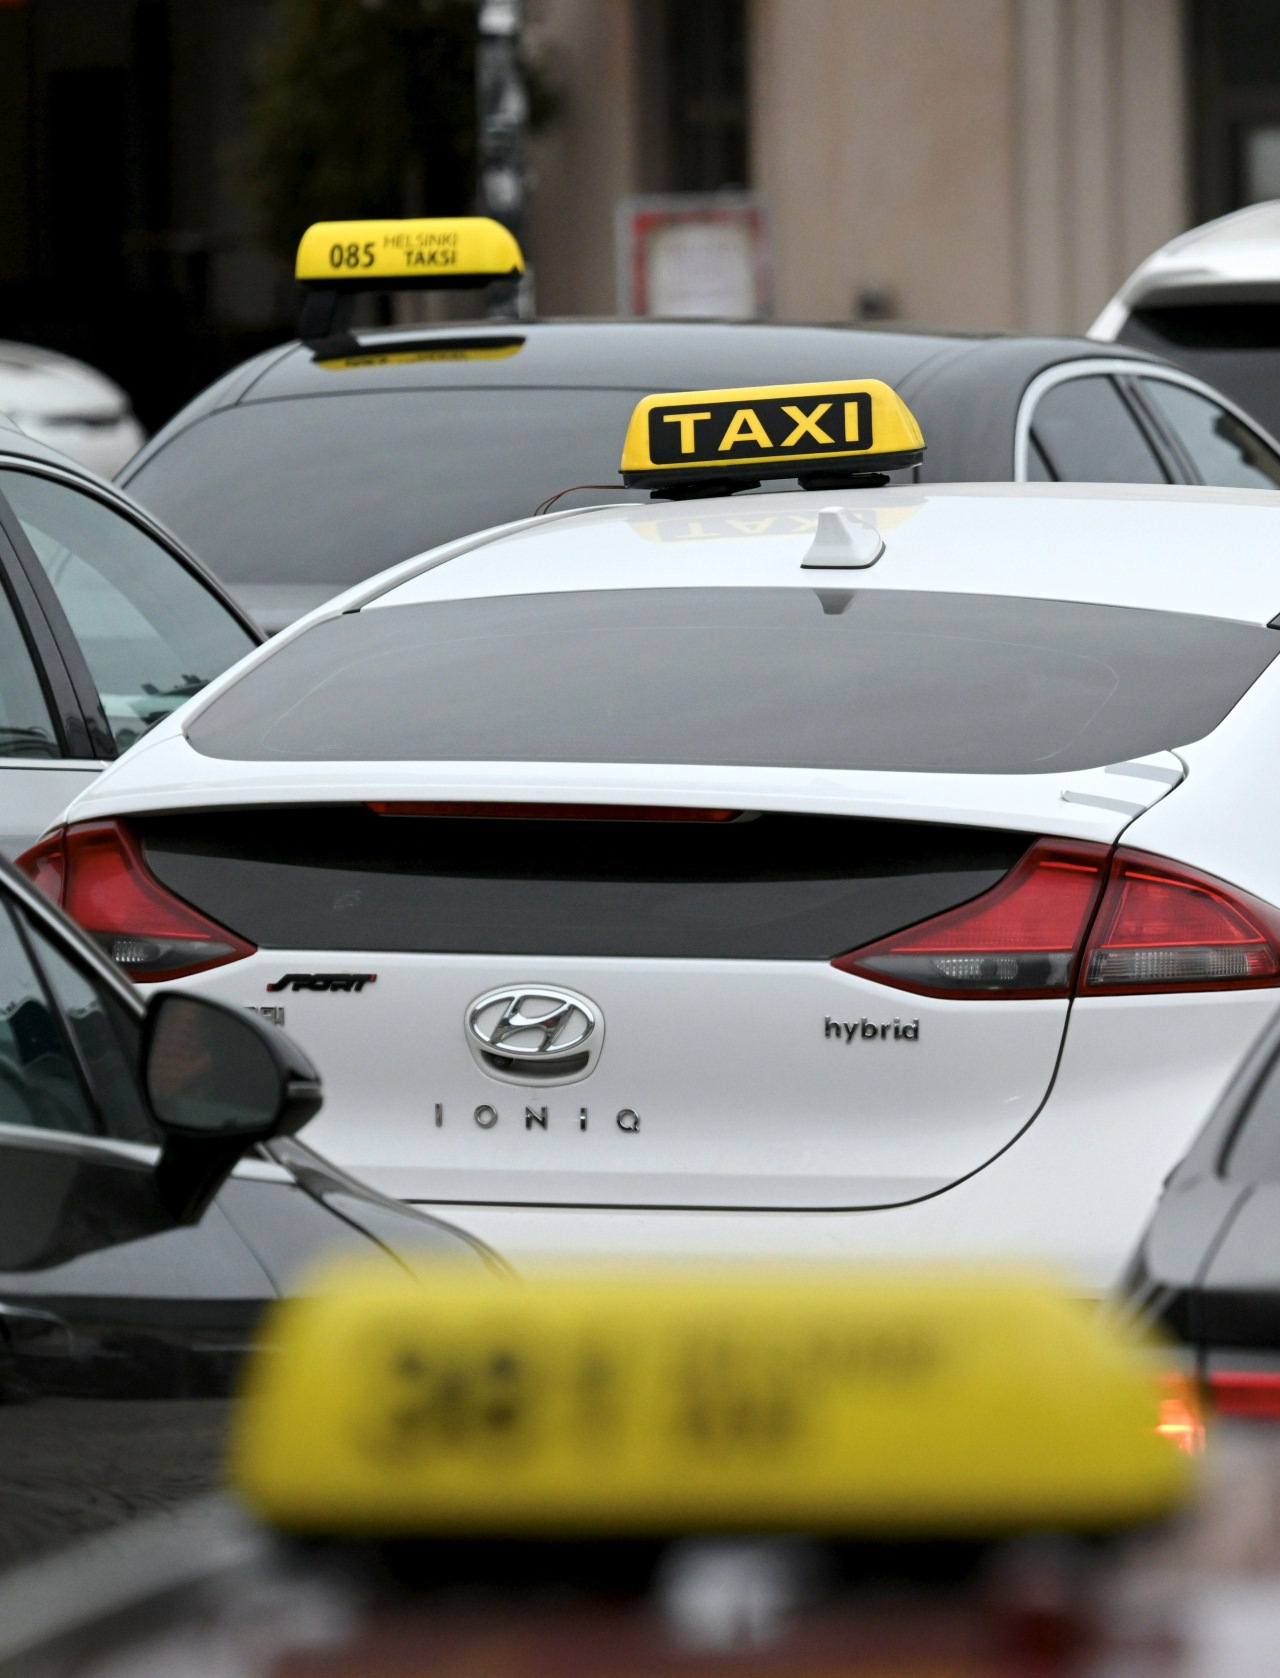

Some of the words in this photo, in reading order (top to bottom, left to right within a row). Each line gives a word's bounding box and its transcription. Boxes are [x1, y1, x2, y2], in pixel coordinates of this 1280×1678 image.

[383, 232, 457, 248] HELSINKI
[329, 242, 375, 269] 085
[404, 250, 457, 267] TAKSI
[663, 401, 860, 454] TAXI
[266, 973, 377, 993] SPORT
[824, 1015, 919, 1045] hybrid
[435, 1102, 641, 1133] IONIQ
